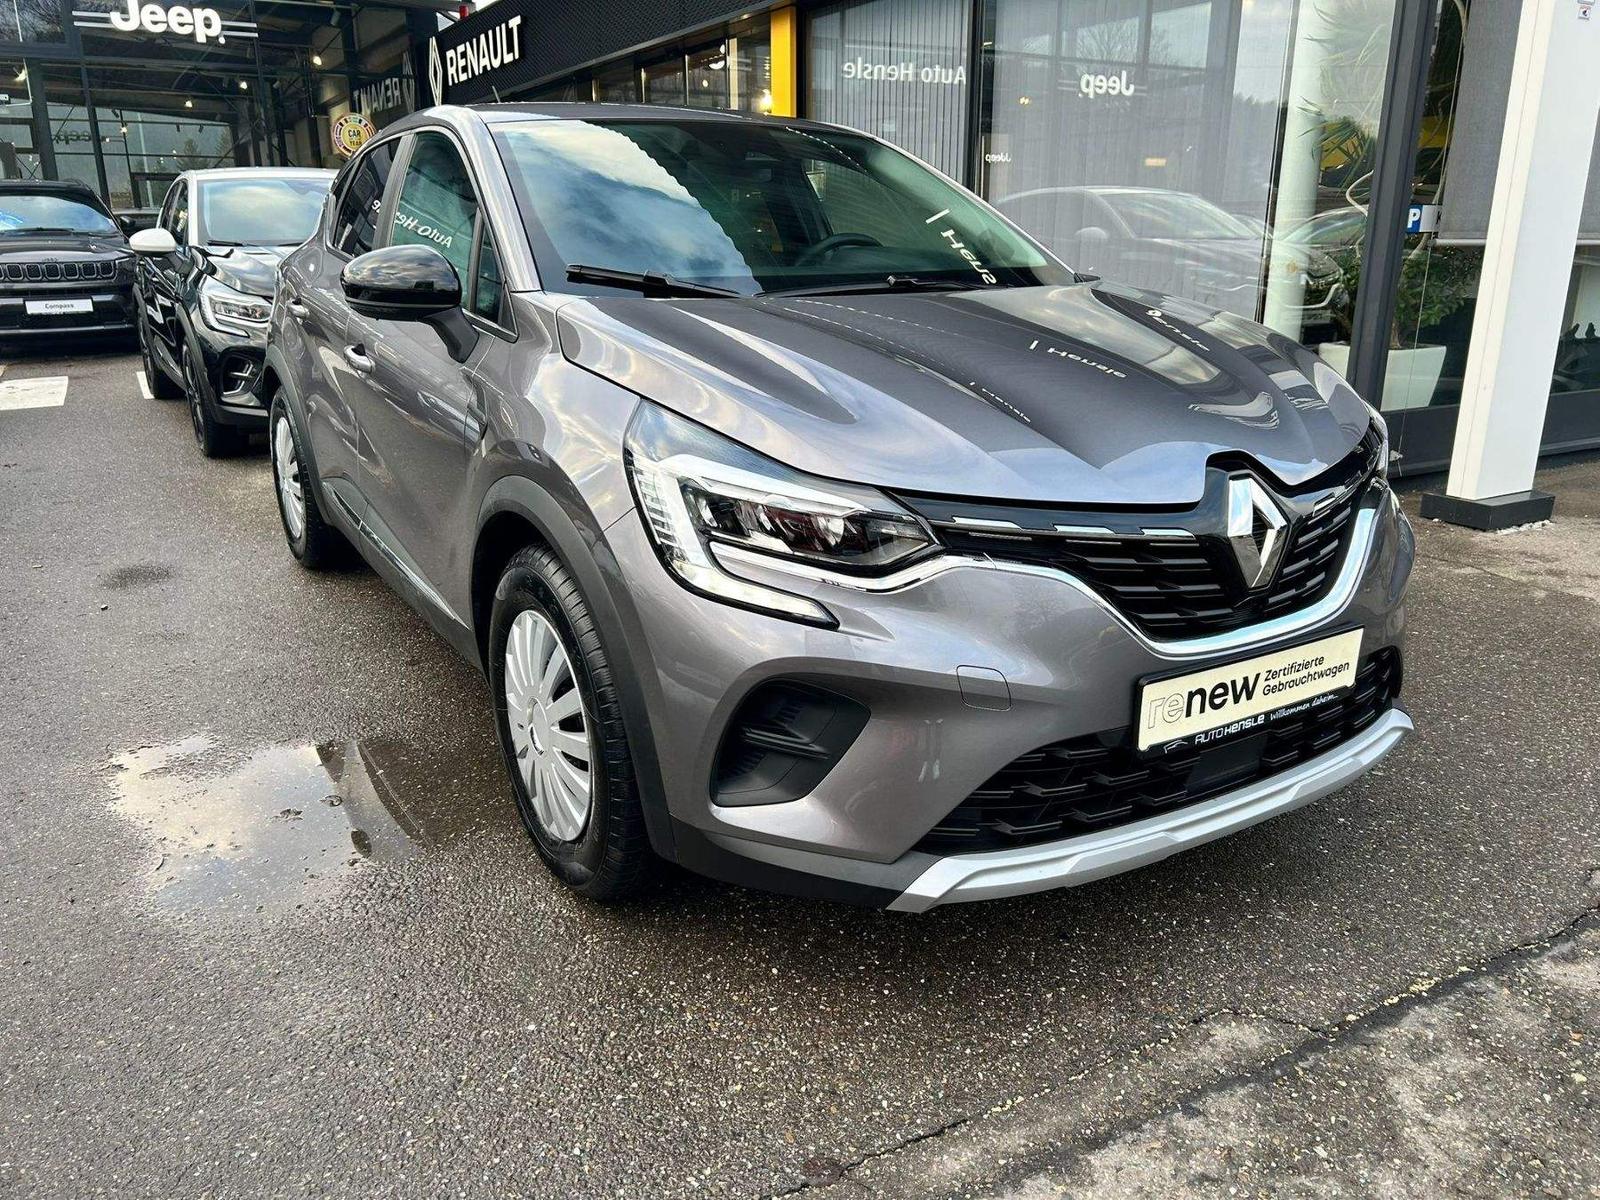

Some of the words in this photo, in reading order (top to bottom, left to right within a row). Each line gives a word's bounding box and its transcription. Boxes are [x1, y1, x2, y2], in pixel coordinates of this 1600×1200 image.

[446, 15, 521, 87] RENAULT
[1262, 661, 1350, 696] Gebrauchtwagen
[1263, 655, 1325, 682] Zertifizierte
[1147, 671, 1261, 729] renew
